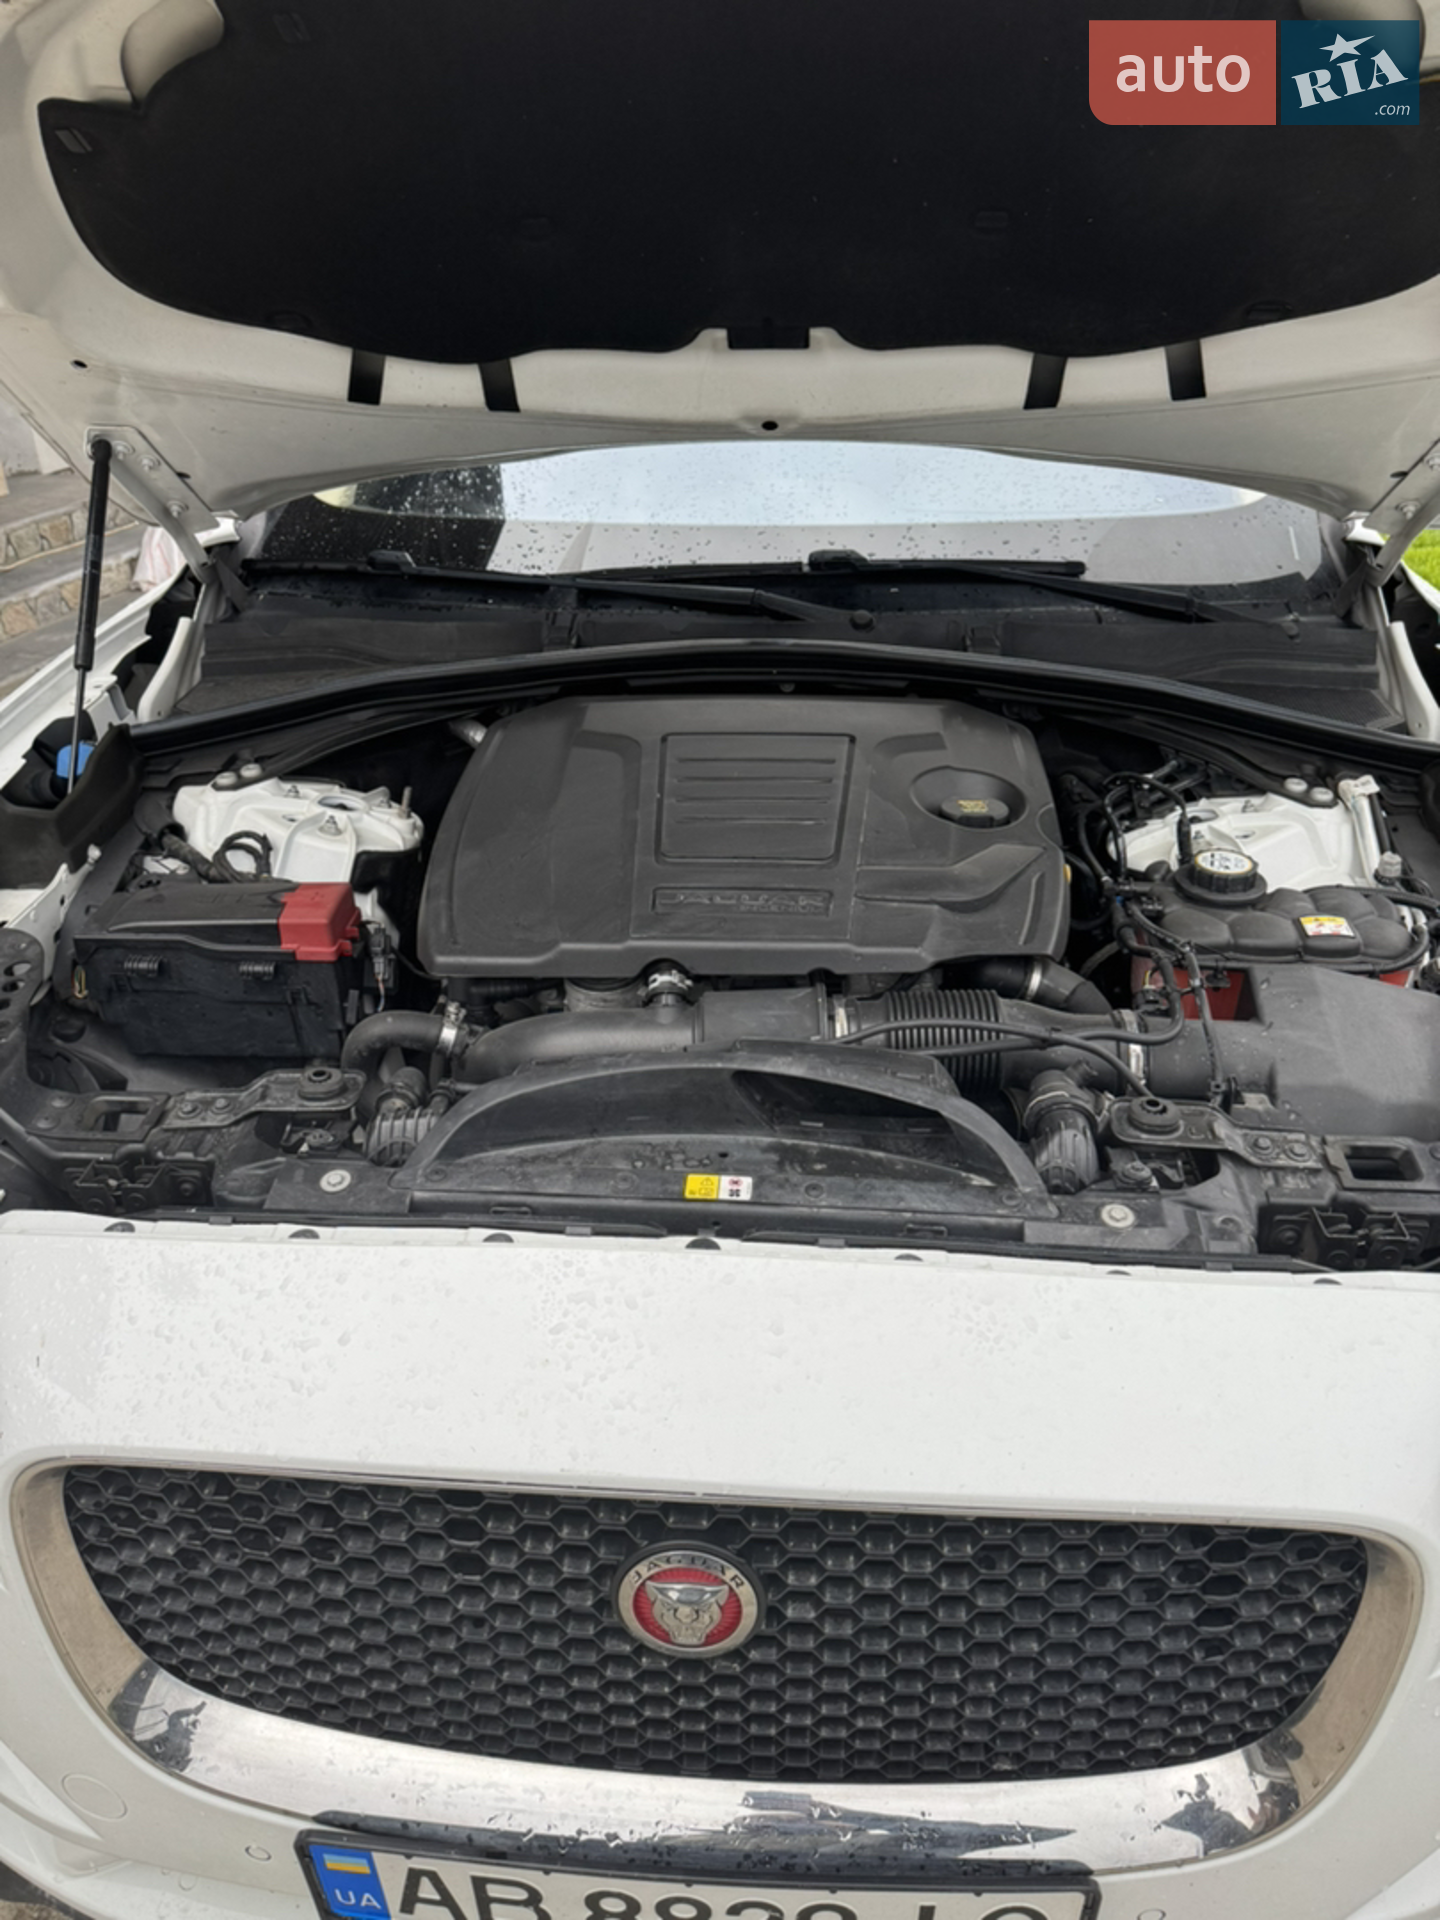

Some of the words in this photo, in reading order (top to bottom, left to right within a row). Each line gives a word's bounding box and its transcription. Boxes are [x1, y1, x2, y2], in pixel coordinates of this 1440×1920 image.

[631, 1554, 746, 1590] JAGUAR
[333, 1888, 382, 1910] UA
[399, 1866, 553, 1920] AB
